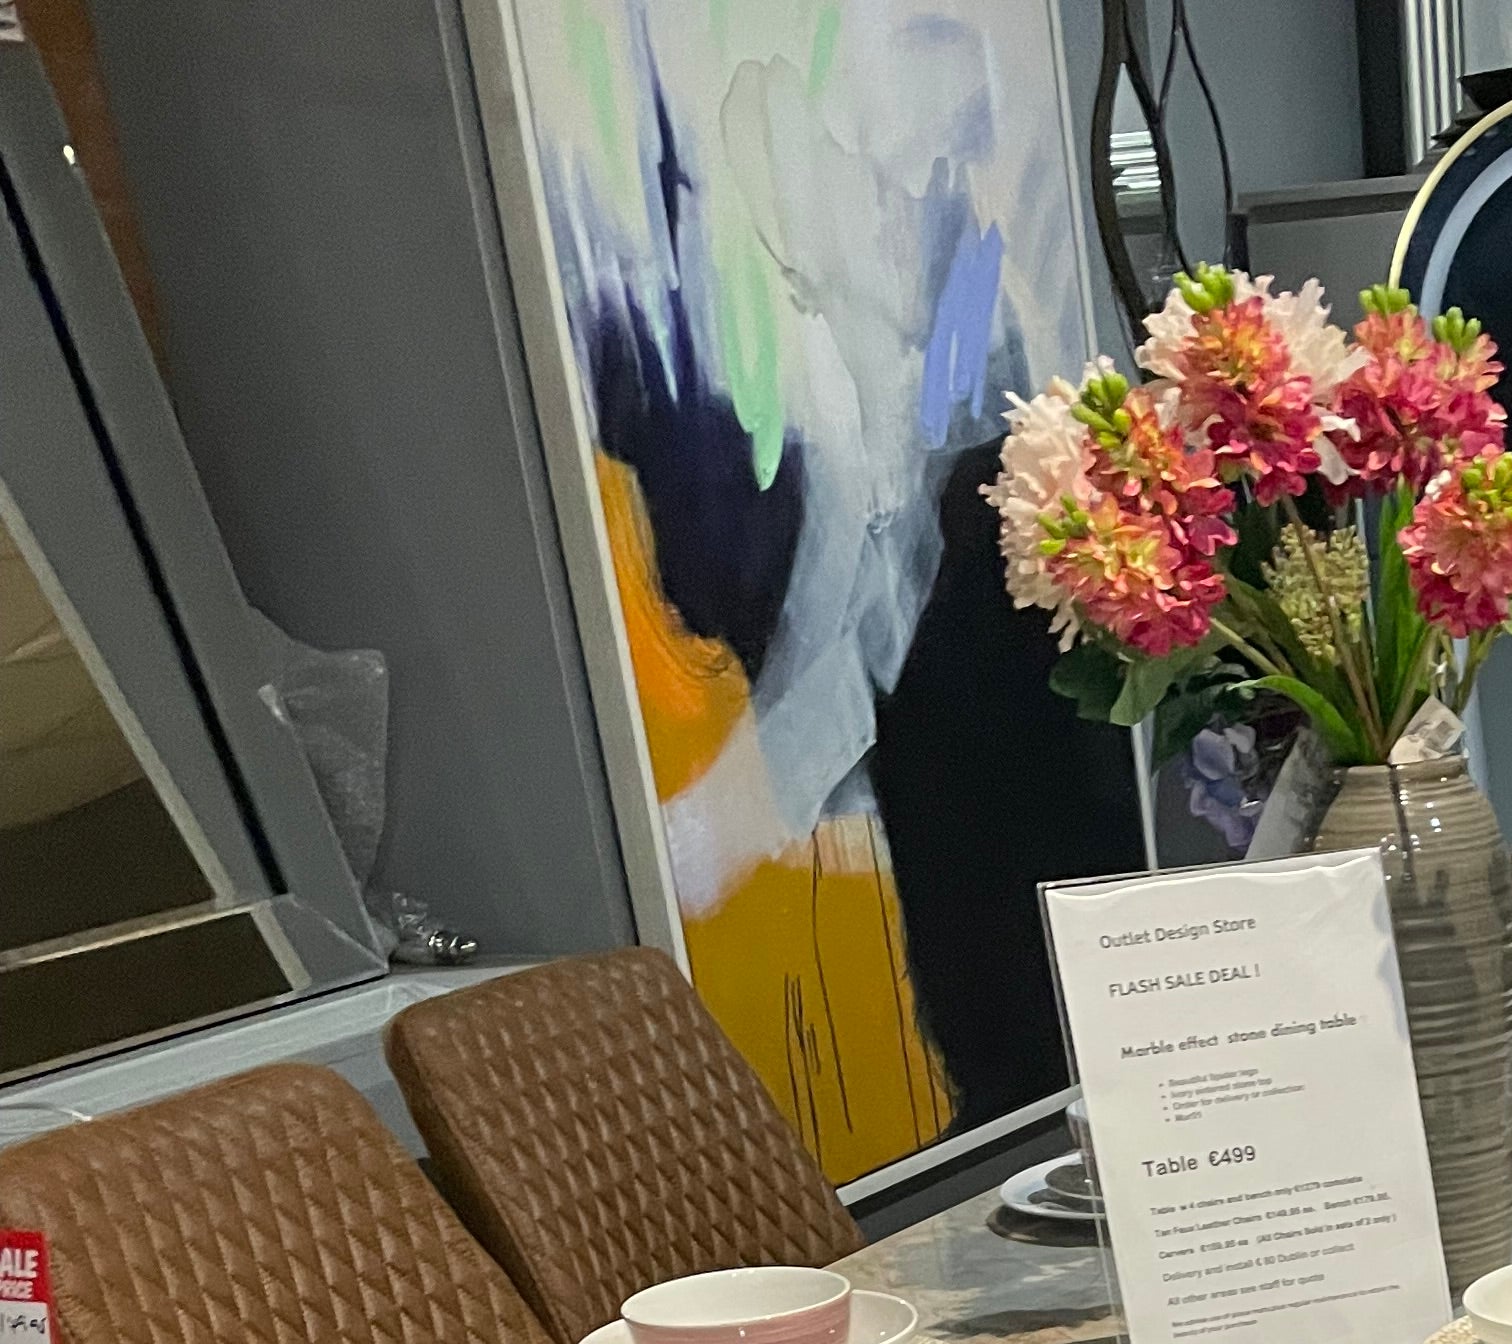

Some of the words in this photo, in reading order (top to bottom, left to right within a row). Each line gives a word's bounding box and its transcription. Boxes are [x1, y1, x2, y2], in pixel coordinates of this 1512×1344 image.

[1099, 930, 1152, 949] Outlet
[1154, 924, 1210, 941] Design
[1212, 918, 1257, 934] Store
[1108, 977, 1161, 997] FLASH
[1164, 971, 1206, 990] SALE
[1208, 965, 1252, 984] DEAL
[1120, 1039, 1175, 1060] Marble
[1178, 1035, 1219, 1050] effect
[1227, 1030, 1267, 1044] stone
[1271, 1020, 1316, 1035] dining
[1319, 1012, 1357, 1030] table
[1141, 1154, 1199, 1178] Table
[1207, 1145, 1257, 1167] €499
[0, 1247, 39, 1279] ALE
[1162, 1269, 1203, 1282] Delivery
[1204, 1265, 1224, 1275] and
[1281, 1277, 1296, 1287] for
